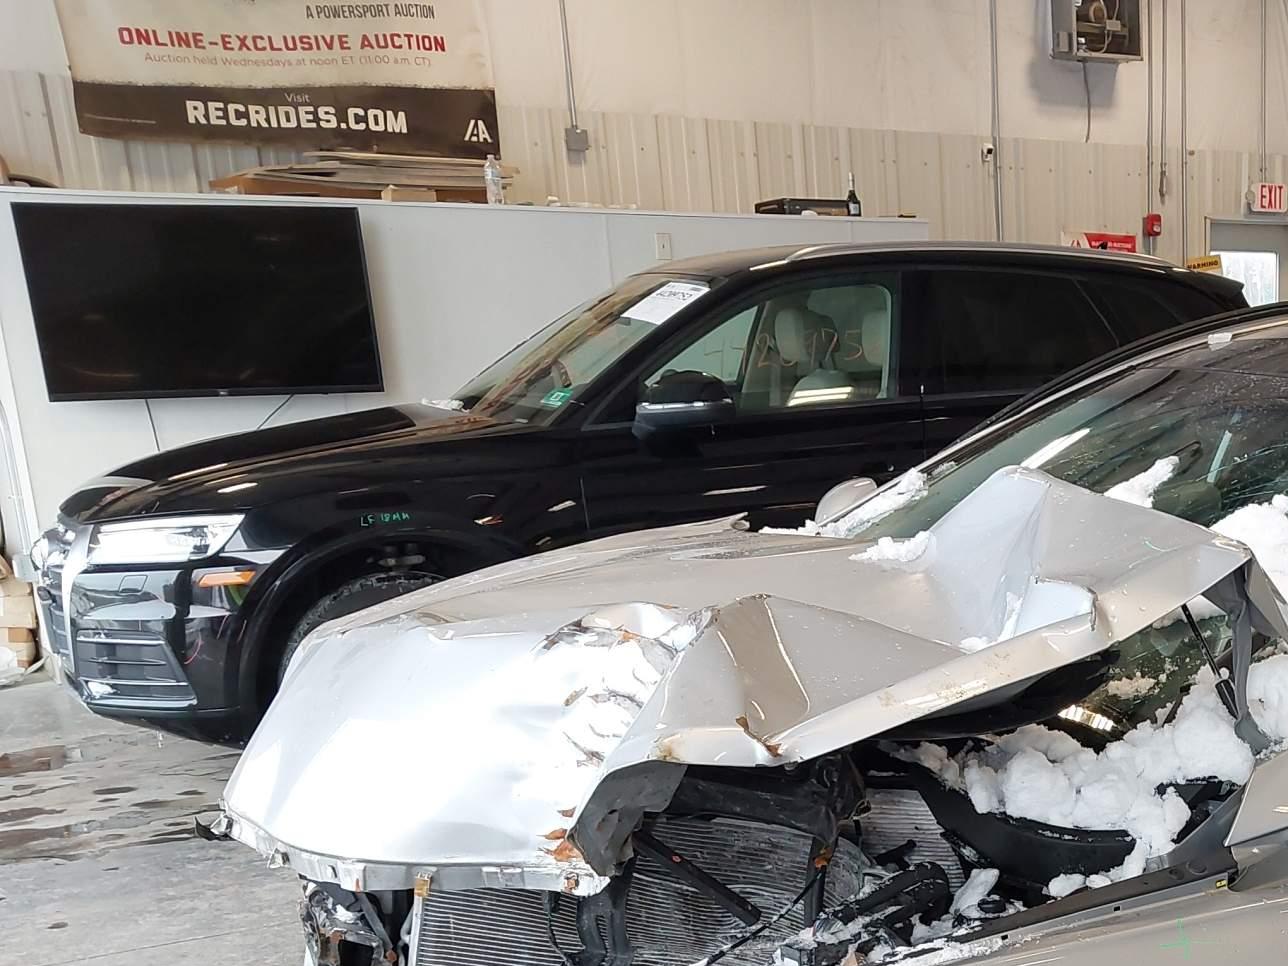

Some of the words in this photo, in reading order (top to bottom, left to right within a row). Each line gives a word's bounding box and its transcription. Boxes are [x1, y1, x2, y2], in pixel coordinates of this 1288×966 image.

[306, 5, 314, 19] A
[317, 4, 390, 19] POWERSPORT
[394, 4, 435, 19] AUCTION
[118, 27, 351, 51] ONLINE-EXCLUSIVE
[360, 33, 446, 52] AUCTION
[145, 53, 190, 65] Auction
[193, 55, 218, 66] held
[221, 56, 292, 68] Wednesdays
[296, 56, 306, 66] at
[310, 57, 338, 66] noon
[342, 55, 355, 65] ET
[285, 92, 311, 103] Visit
[186, 100, 408, 133] RECRIDES.COM
[1260, 184, 1284, 210] EXIT
[361, 514, 375, 526] LF
